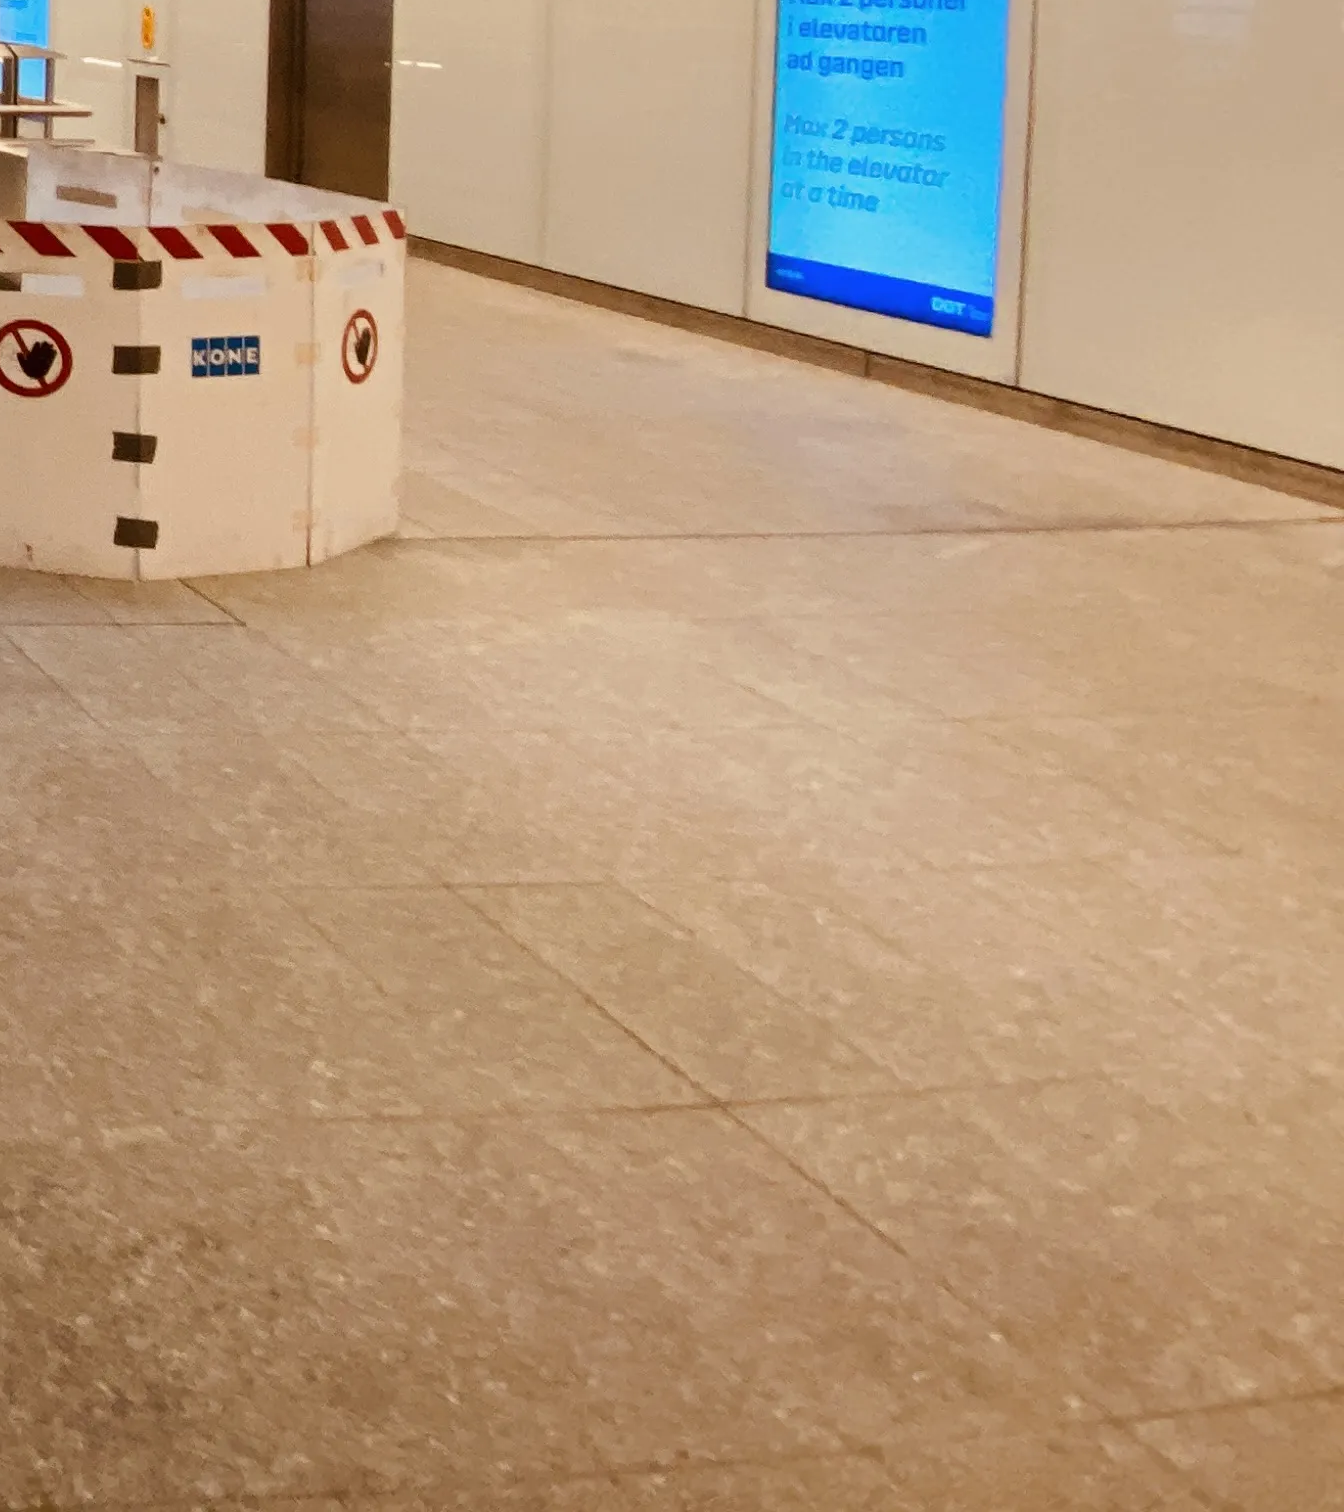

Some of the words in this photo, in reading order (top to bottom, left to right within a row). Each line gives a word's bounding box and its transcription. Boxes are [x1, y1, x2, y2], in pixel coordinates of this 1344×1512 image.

[799, 18, 928, 44] elevatoren
[787, 52, 813, 71] ad
[818, 56, 905, 80] gangen
[783, 114, 827, 137] Max
[832, 118, 849, 140] 2
[851, 124, 947, 152] persons
[807, 149, 844, 174] the
[848, 155, 951, 188] elevator
[781, 180, 805, 201] at
[826, 185, 881, 213] time
[193, 347, 259, 366] KONE
